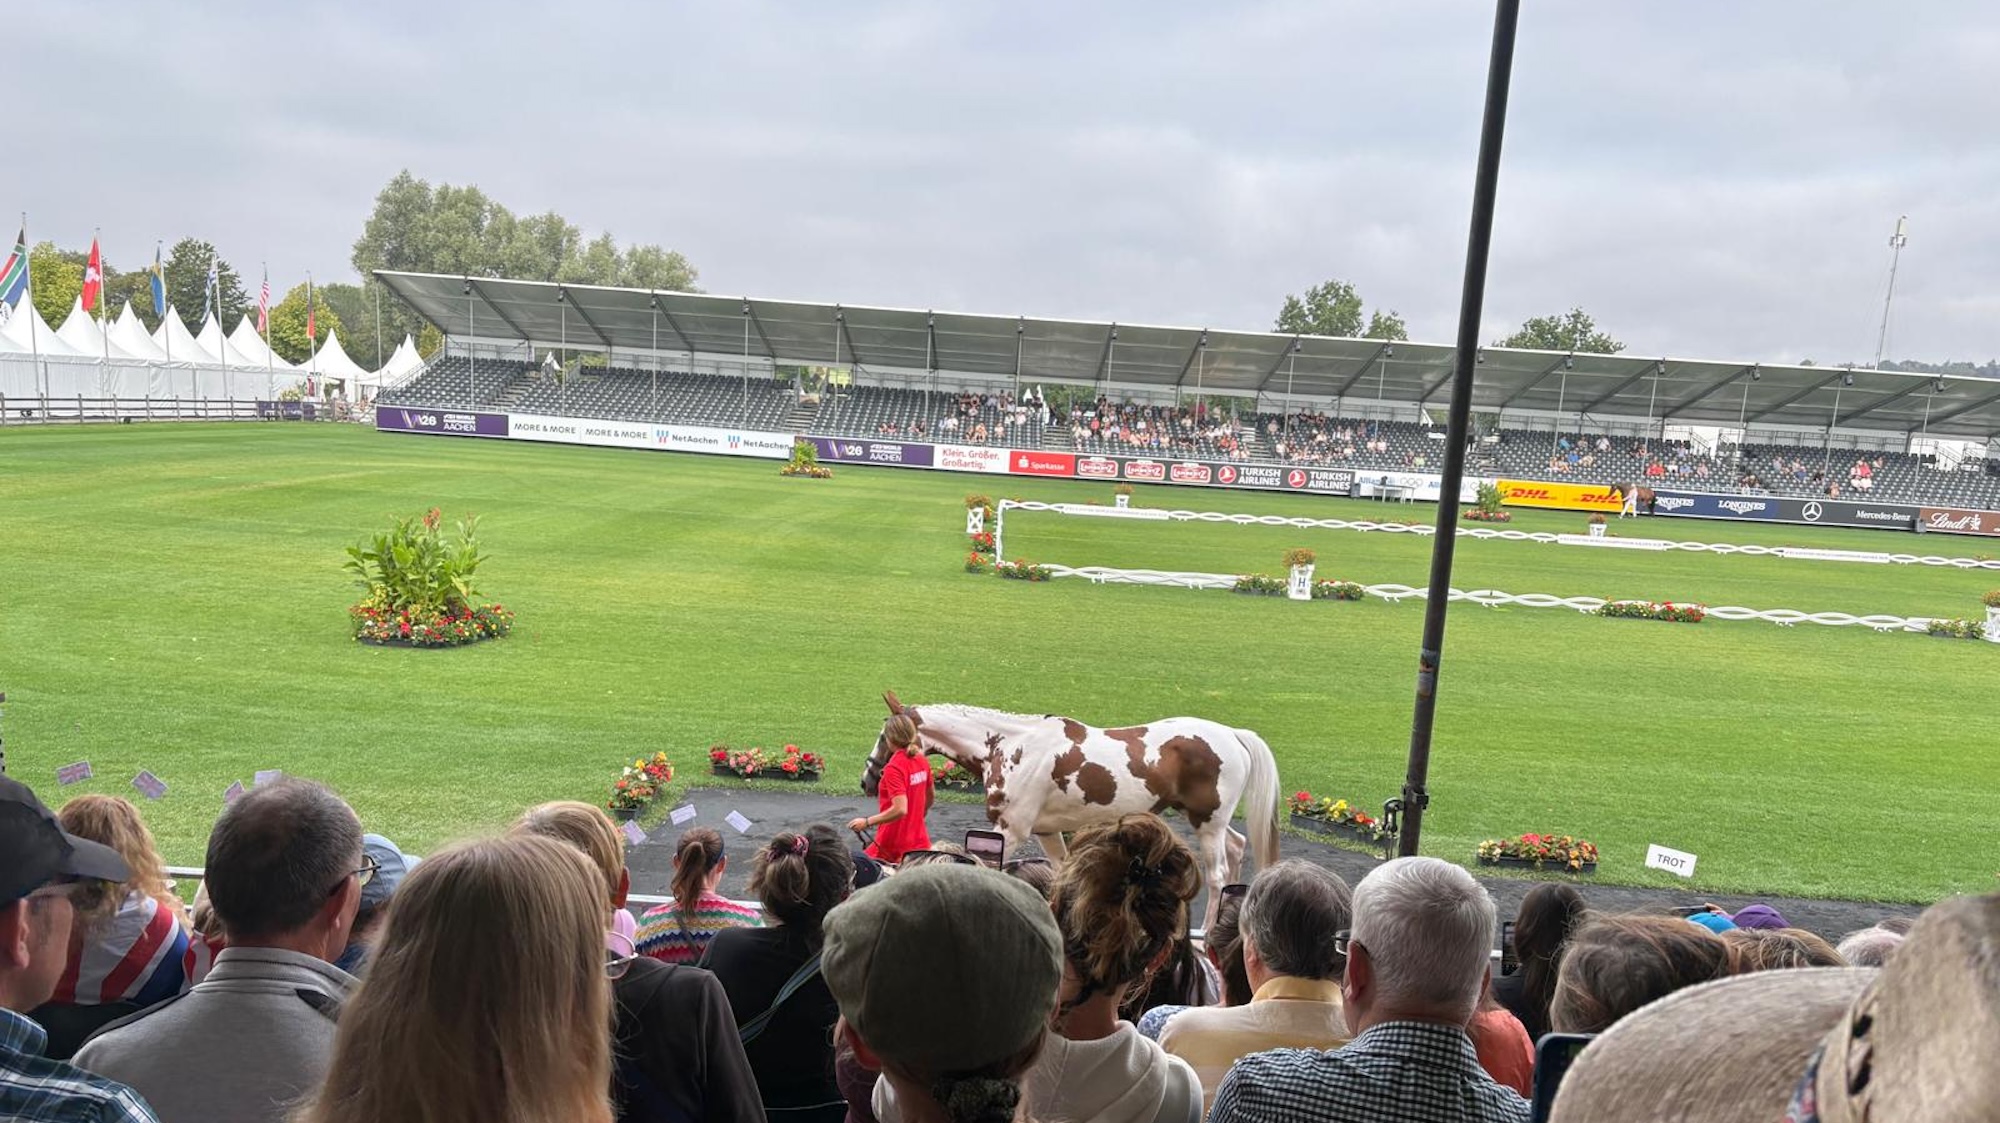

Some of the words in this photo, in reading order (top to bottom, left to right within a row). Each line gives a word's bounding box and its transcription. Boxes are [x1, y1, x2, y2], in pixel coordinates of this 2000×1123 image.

[443, 422, 476, 431] AACHEN
[514, 423, 541, 432] MORE
[549, 425, 576, 434] MORE
[585, 428, 612, 437] MORE
[621, 430, 648, 439] MORE
[672, 434, 719, 445] NetAachen
[743, 439, 790, 450] NetAachen
[870, 452, 902, 462] AACHEN
[942, 449, 967, 458] Klein.
[942, 458, 986, 470] Großartig.
[1031, 461, 1065, 471] Sparkasse
[1240, 467, 1281, 477] TURKISH
[1309, 471, 1351, 482] TURKISH
[1238, 476, 1281, 486] AIRLINES
[1308, 480, 1351, 490] AIRLINES
[1511, 488, 1549, 499] DHL
[1580, 494, 1619, 504] DHL
[1718, 500, 1766, 511] LONGINES
[1856, 510, 1911, 521] Mercedes-Benz
[1926, 512, 1972, 530] Lindt
[1298, 578, 1306, 588] H
[1657, 853, 1686, 869] TROT
